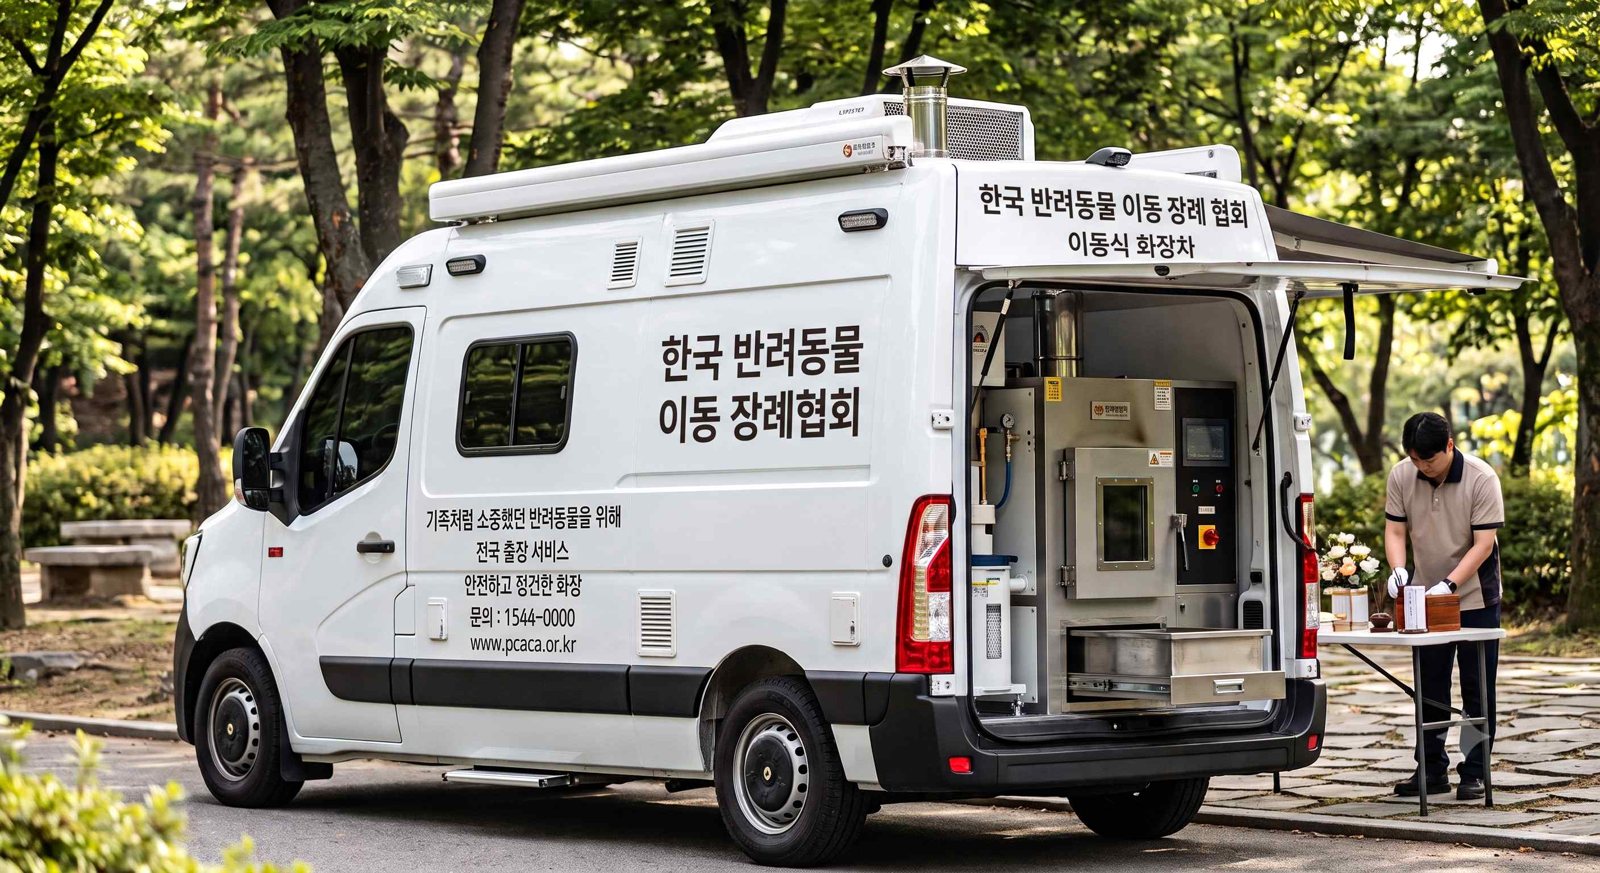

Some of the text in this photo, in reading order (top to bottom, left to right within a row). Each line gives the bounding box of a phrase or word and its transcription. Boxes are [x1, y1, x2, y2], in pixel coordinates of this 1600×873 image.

[979, 183, 1249, 229] 한국 반려동물 이동 장례 협회
[1068, 231, 1196, 259] 이동식 화장차
[661, 325, 864, 382] 한국 반려동물
[659, 386, 860, 444] 이동 장례협회
[477, 507, 526, 531] 소중했던
[529, 505, 592, 530] 반려동물을
[595, 504, 622, 529] 위해
[476, 540, 570, 564] 전국 출장 서비스
[464, 574, 512, 597] 안전하고
[556, 574, 583, 598] 화장
[469, 607, 493, 628] 문의
[504, 607, 576, 628] 1544-0000
[470, 634, 577, 656] www.pcaca.or.kr
